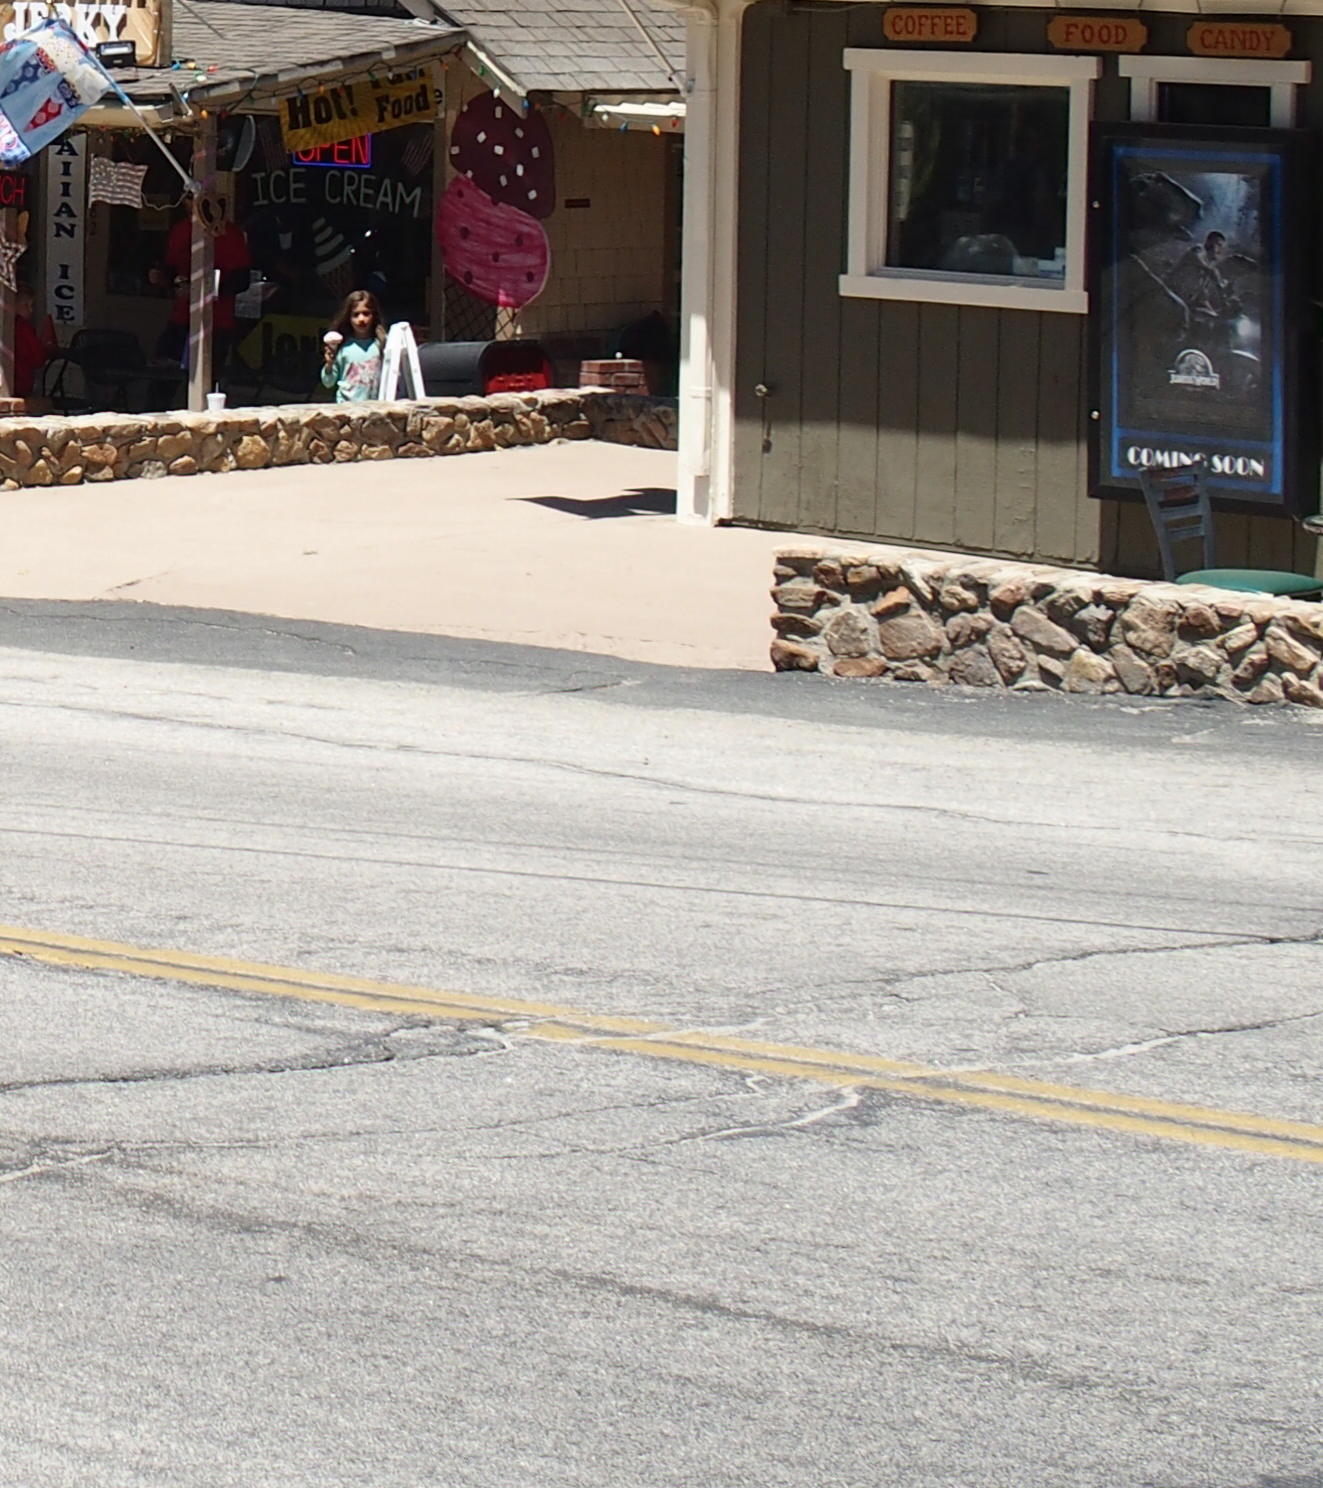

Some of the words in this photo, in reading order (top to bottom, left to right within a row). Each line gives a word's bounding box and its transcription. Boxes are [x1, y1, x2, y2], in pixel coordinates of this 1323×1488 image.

[891, 14, 968, 38] COFFEE
[1063, 23, 1128, 45] FOOD
[1199, 28, 1276, 52] CANDY
[285, 85, 359, 131] Hot!
[374, 83, 431, 124] Food
[250, 168, 307, 206] ICE
[324, 169, 423, 219] CREAM
[1210, 454, 1265, 478] SOON
